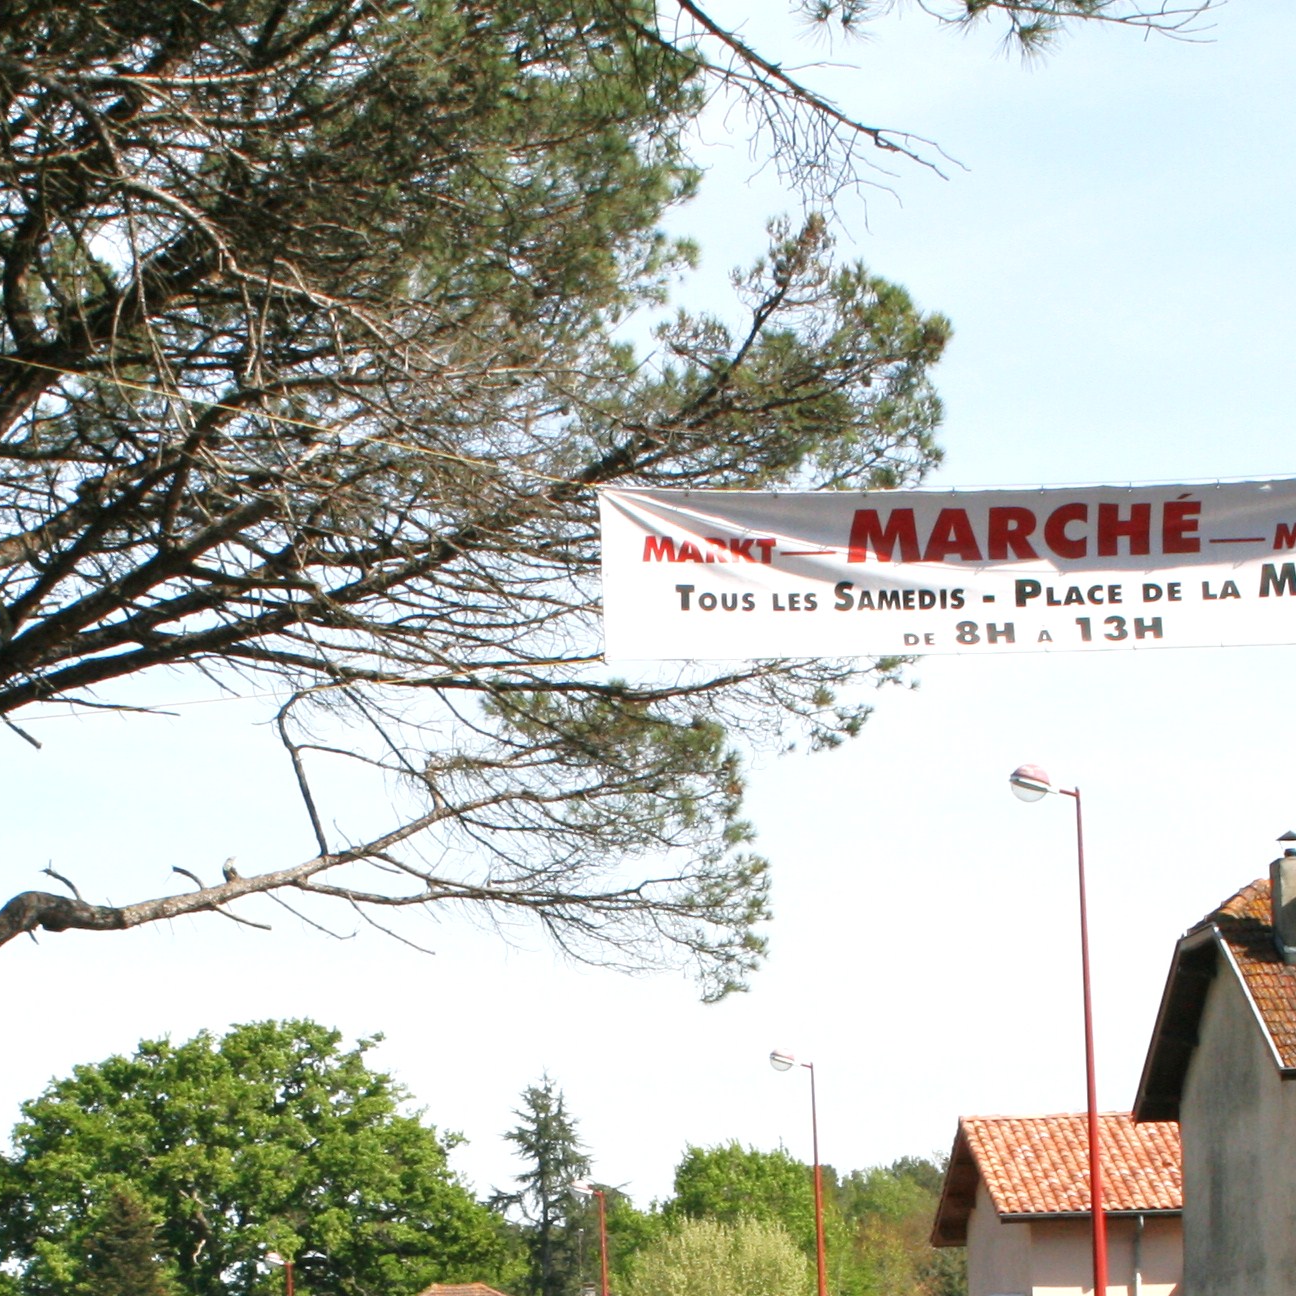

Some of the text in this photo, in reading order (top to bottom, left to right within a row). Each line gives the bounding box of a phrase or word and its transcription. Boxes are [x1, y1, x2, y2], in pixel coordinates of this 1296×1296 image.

[642, 535, 777, 564] MARKT
[847, 493, 1202, 563] MARCHÉ
[955, 621, 1016, 645] 8H
[1075, 616, 1164, 642] 13H
